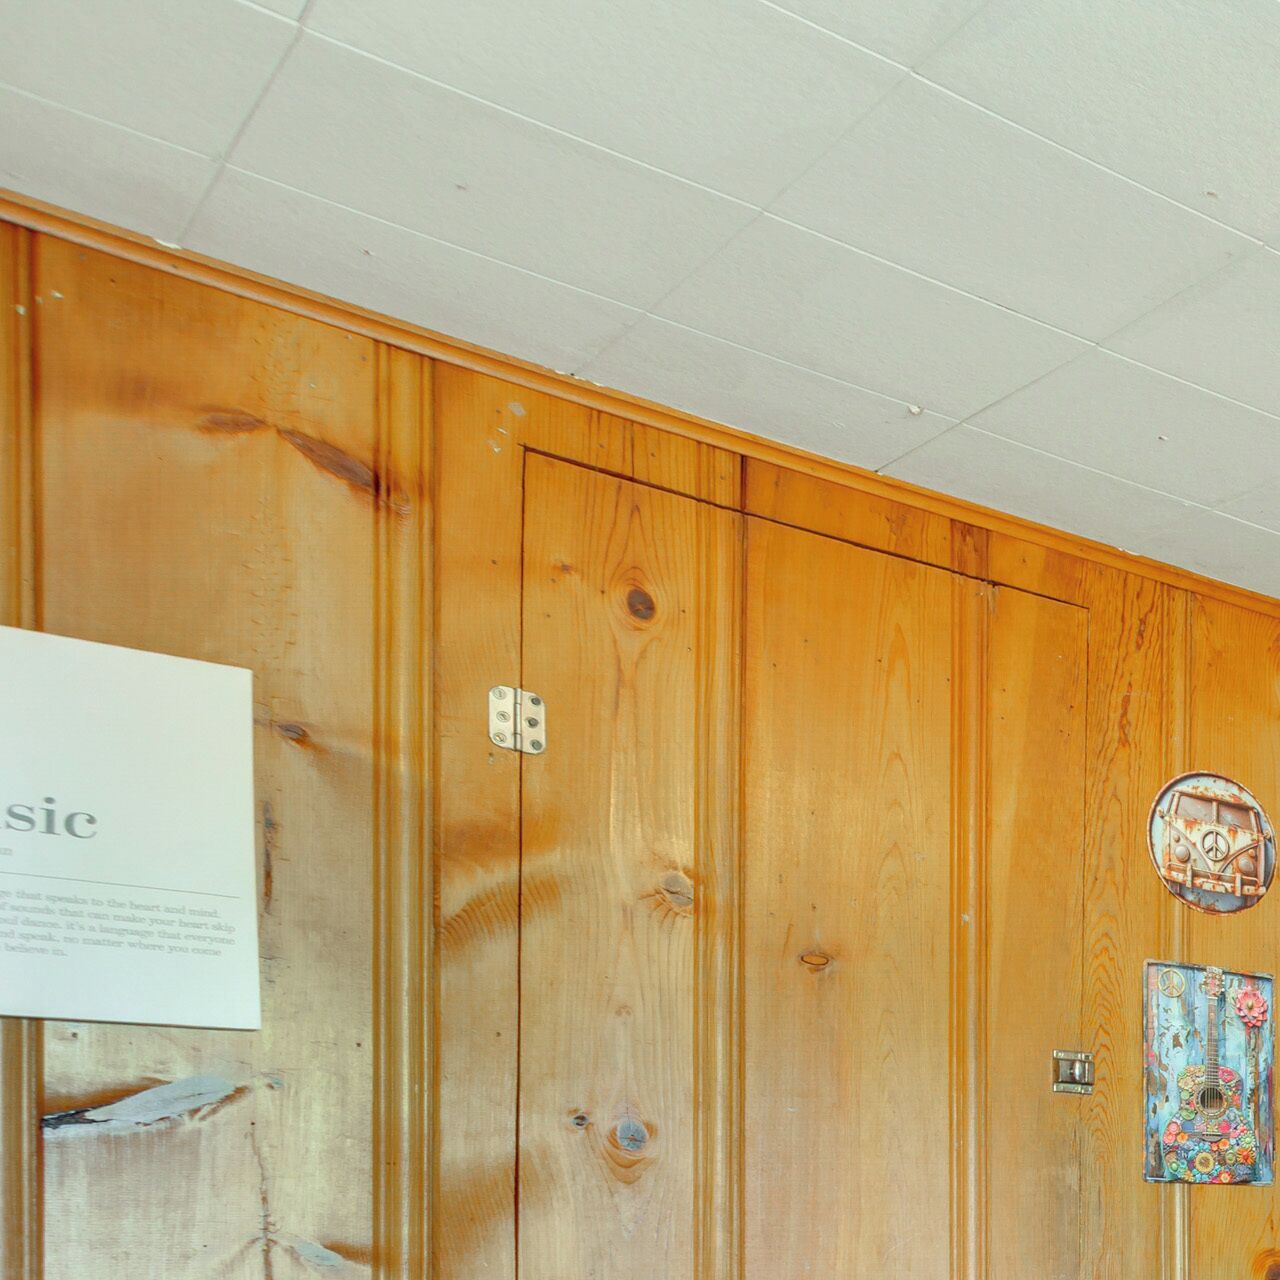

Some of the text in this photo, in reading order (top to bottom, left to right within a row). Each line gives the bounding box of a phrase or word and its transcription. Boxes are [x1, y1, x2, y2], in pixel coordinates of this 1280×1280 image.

[0, 797, 97, 840] sic
[129, 900, 161, 912] heart
[164, 905, 186, 915] and
[178, 919, 209, 930] heart
